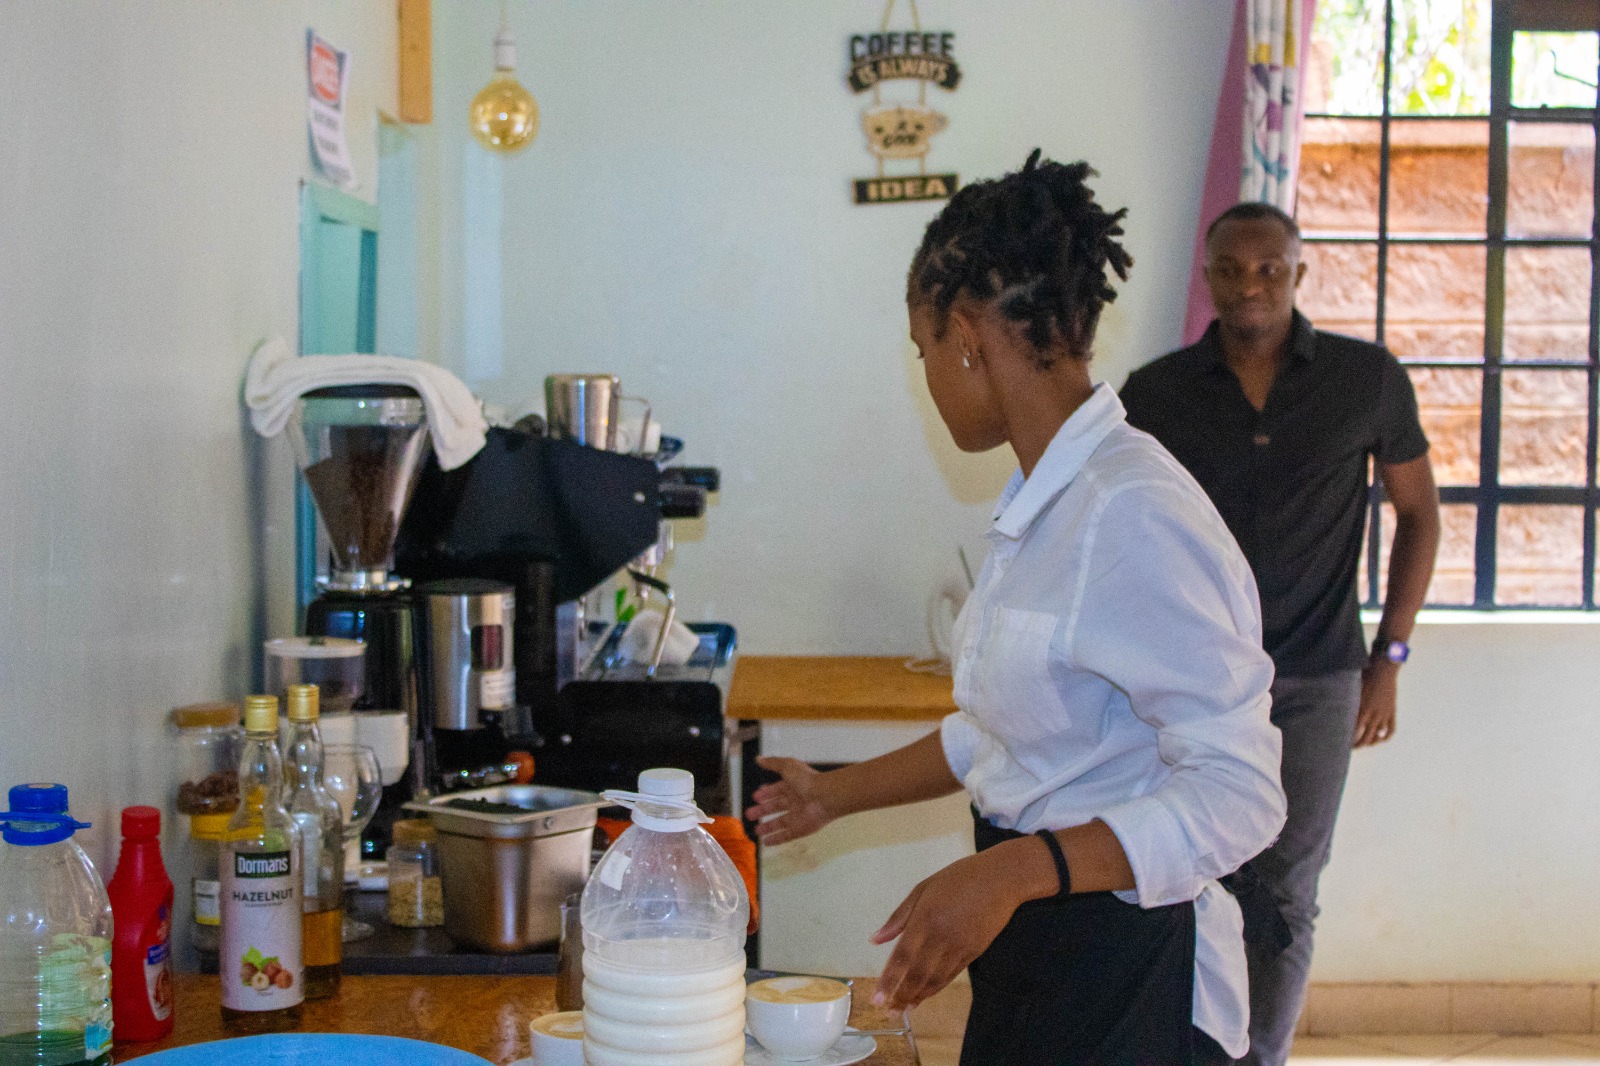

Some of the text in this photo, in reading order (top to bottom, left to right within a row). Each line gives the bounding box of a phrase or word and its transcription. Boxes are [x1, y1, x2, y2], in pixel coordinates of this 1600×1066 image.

[850, 32, 954, 60] COFFEE
[868, 178, 947, 200] IDEA
[237, 856, 288, 873] Dormans
[232, 888, 293, 902] HAZELNUT
